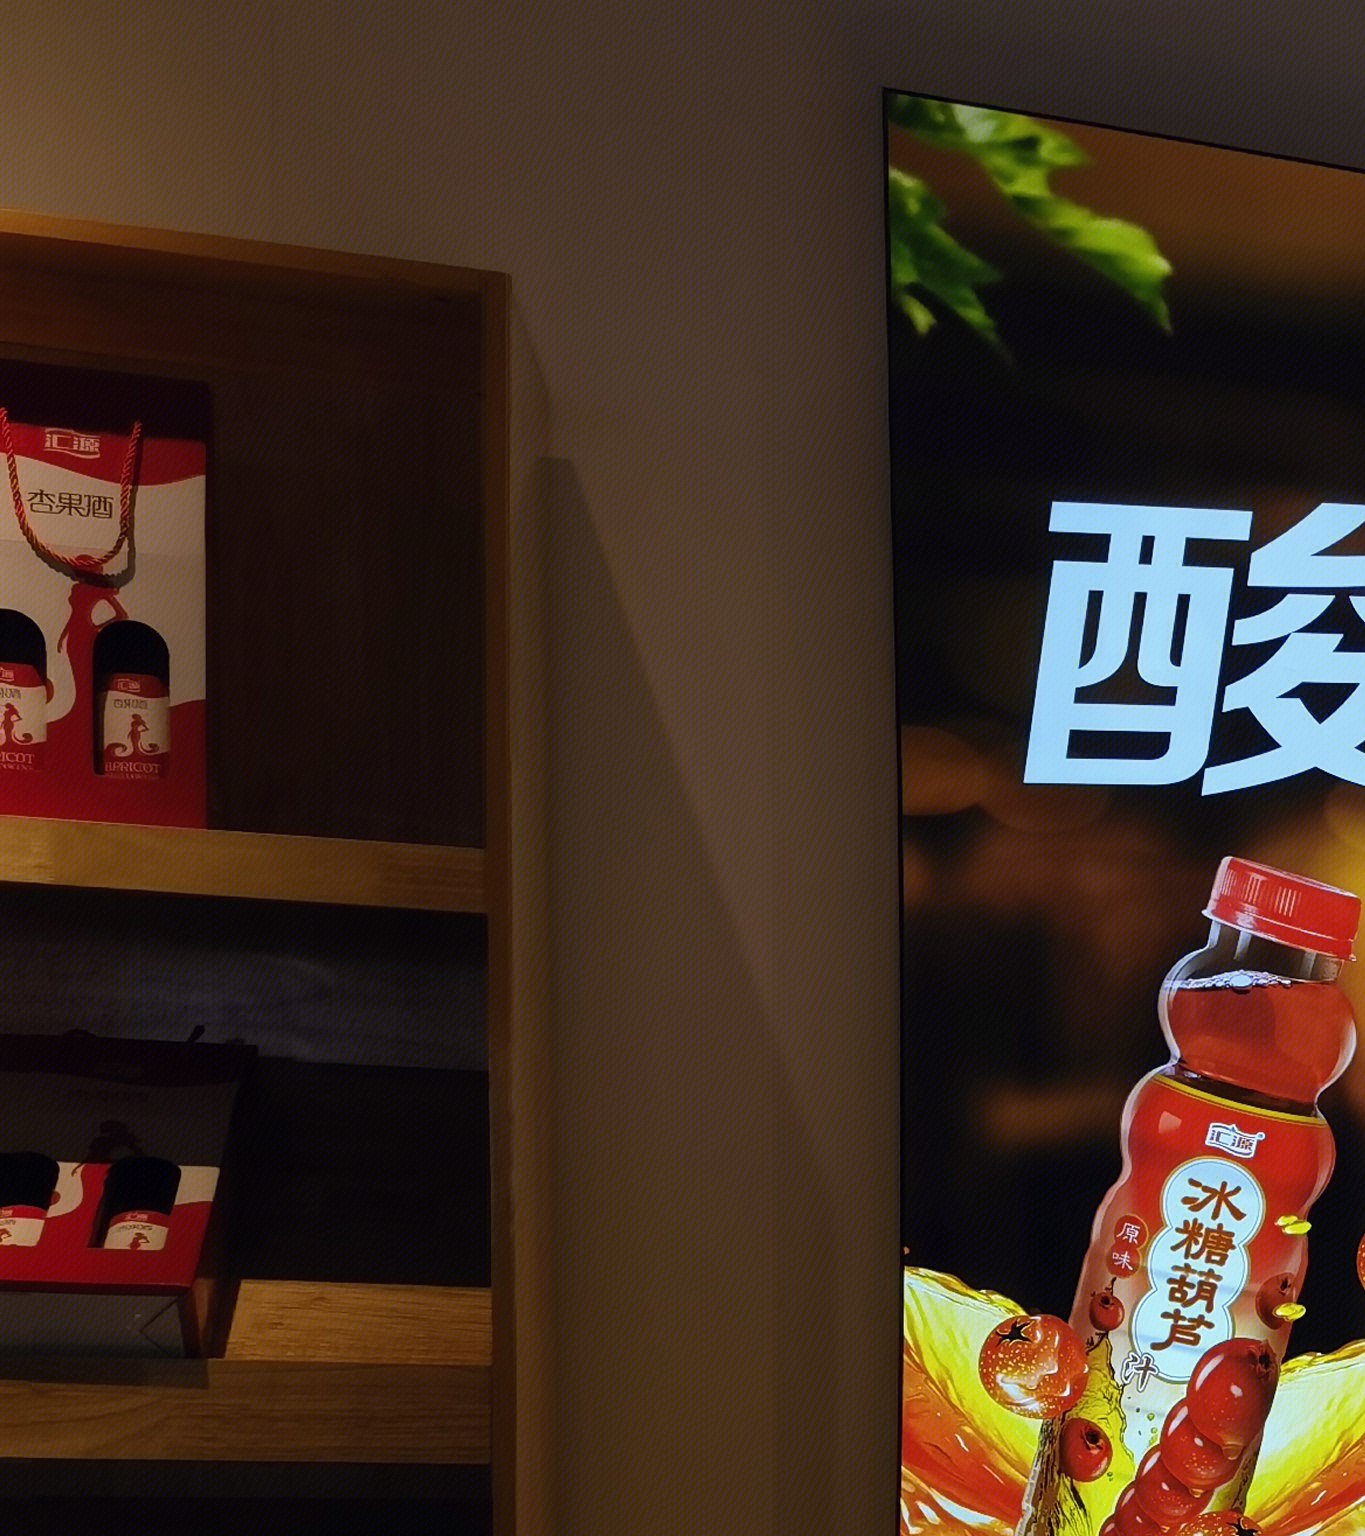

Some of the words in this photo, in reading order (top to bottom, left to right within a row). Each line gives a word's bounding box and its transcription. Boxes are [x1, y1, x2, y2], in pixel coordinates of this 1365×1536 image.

[28, 488, 115, 519] 杏果酒
[1112, 1221, 1140, 1271] 原味
[1150, 1177, 1247, 1351] 冰糖葫芦
